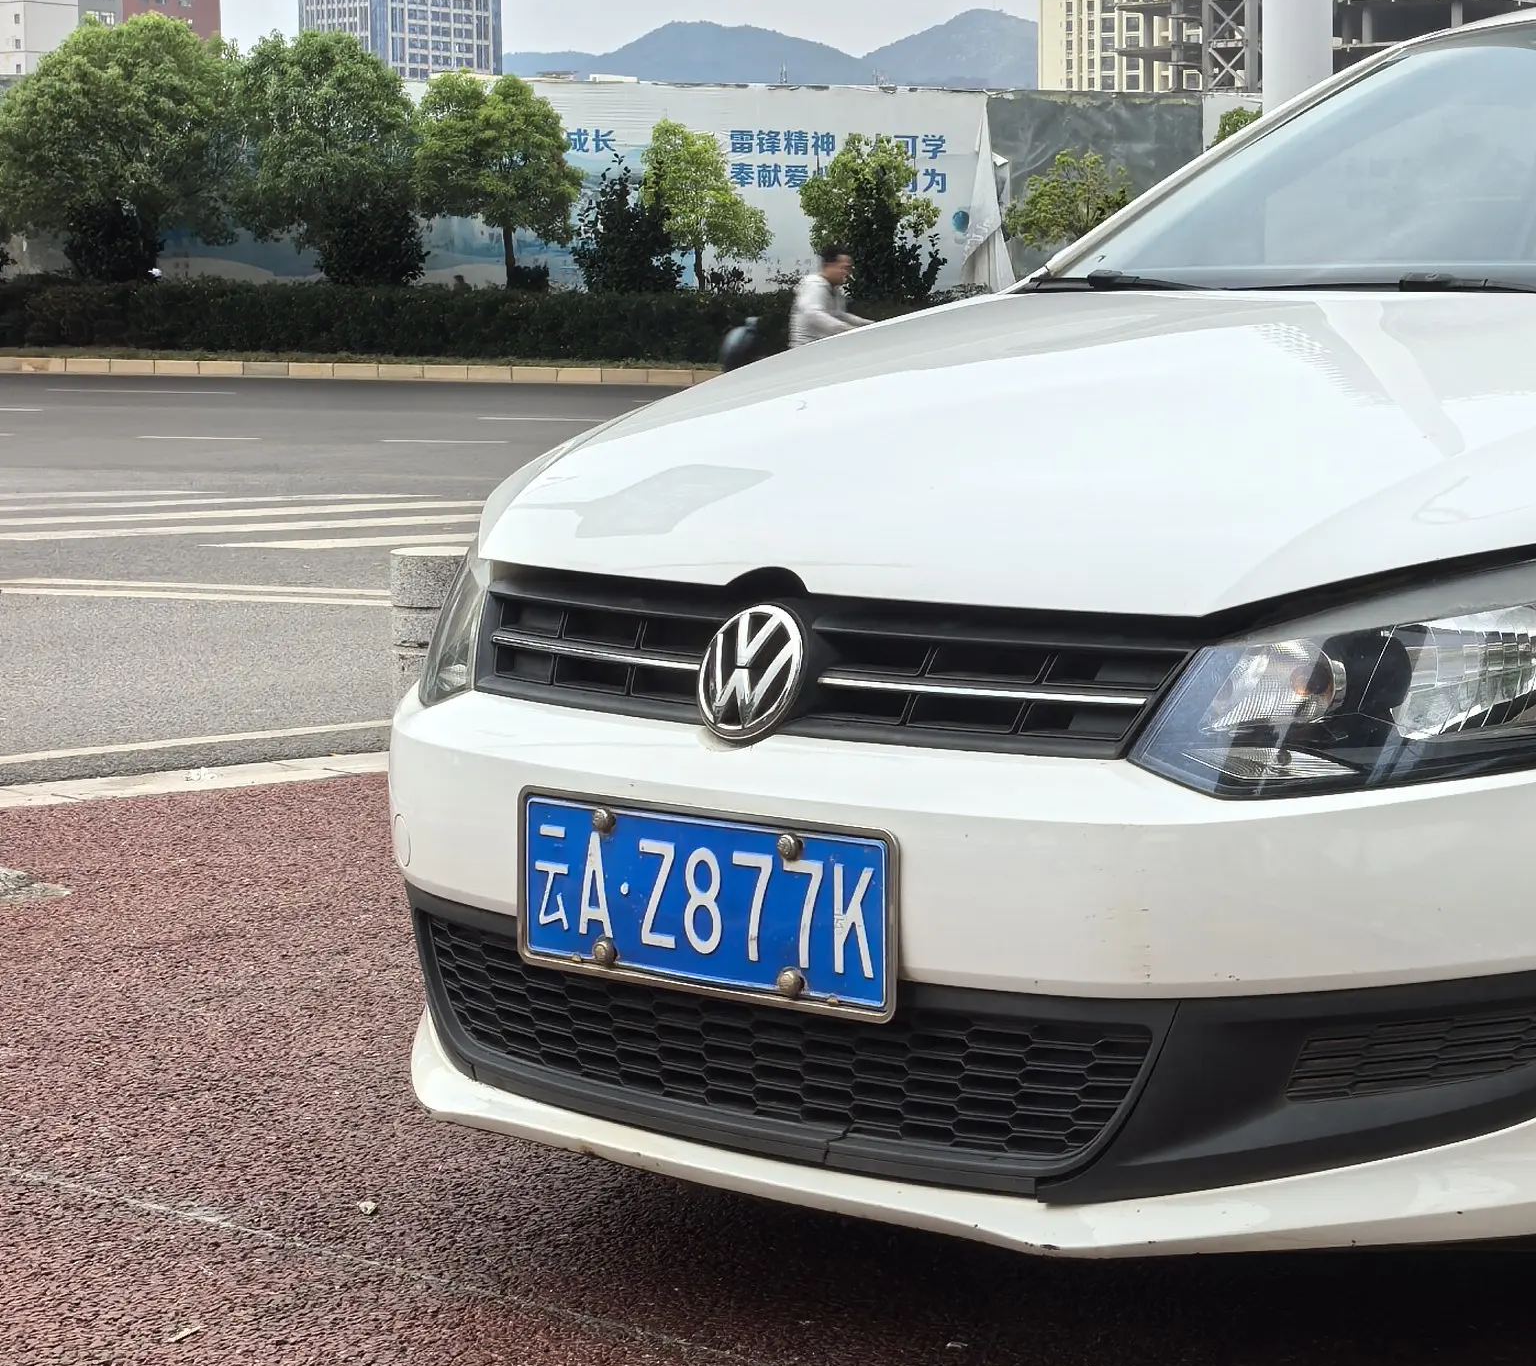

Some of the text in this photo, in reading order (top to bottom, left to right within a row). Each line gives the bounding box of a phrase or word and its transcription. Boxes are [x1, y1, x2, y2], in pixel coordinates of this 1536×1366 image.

[567, 128, 617, 153] 成长
[729, 129, 947, 160] 雷锋精神可学
[534, 825, 875, 980] 云A·Z877K
